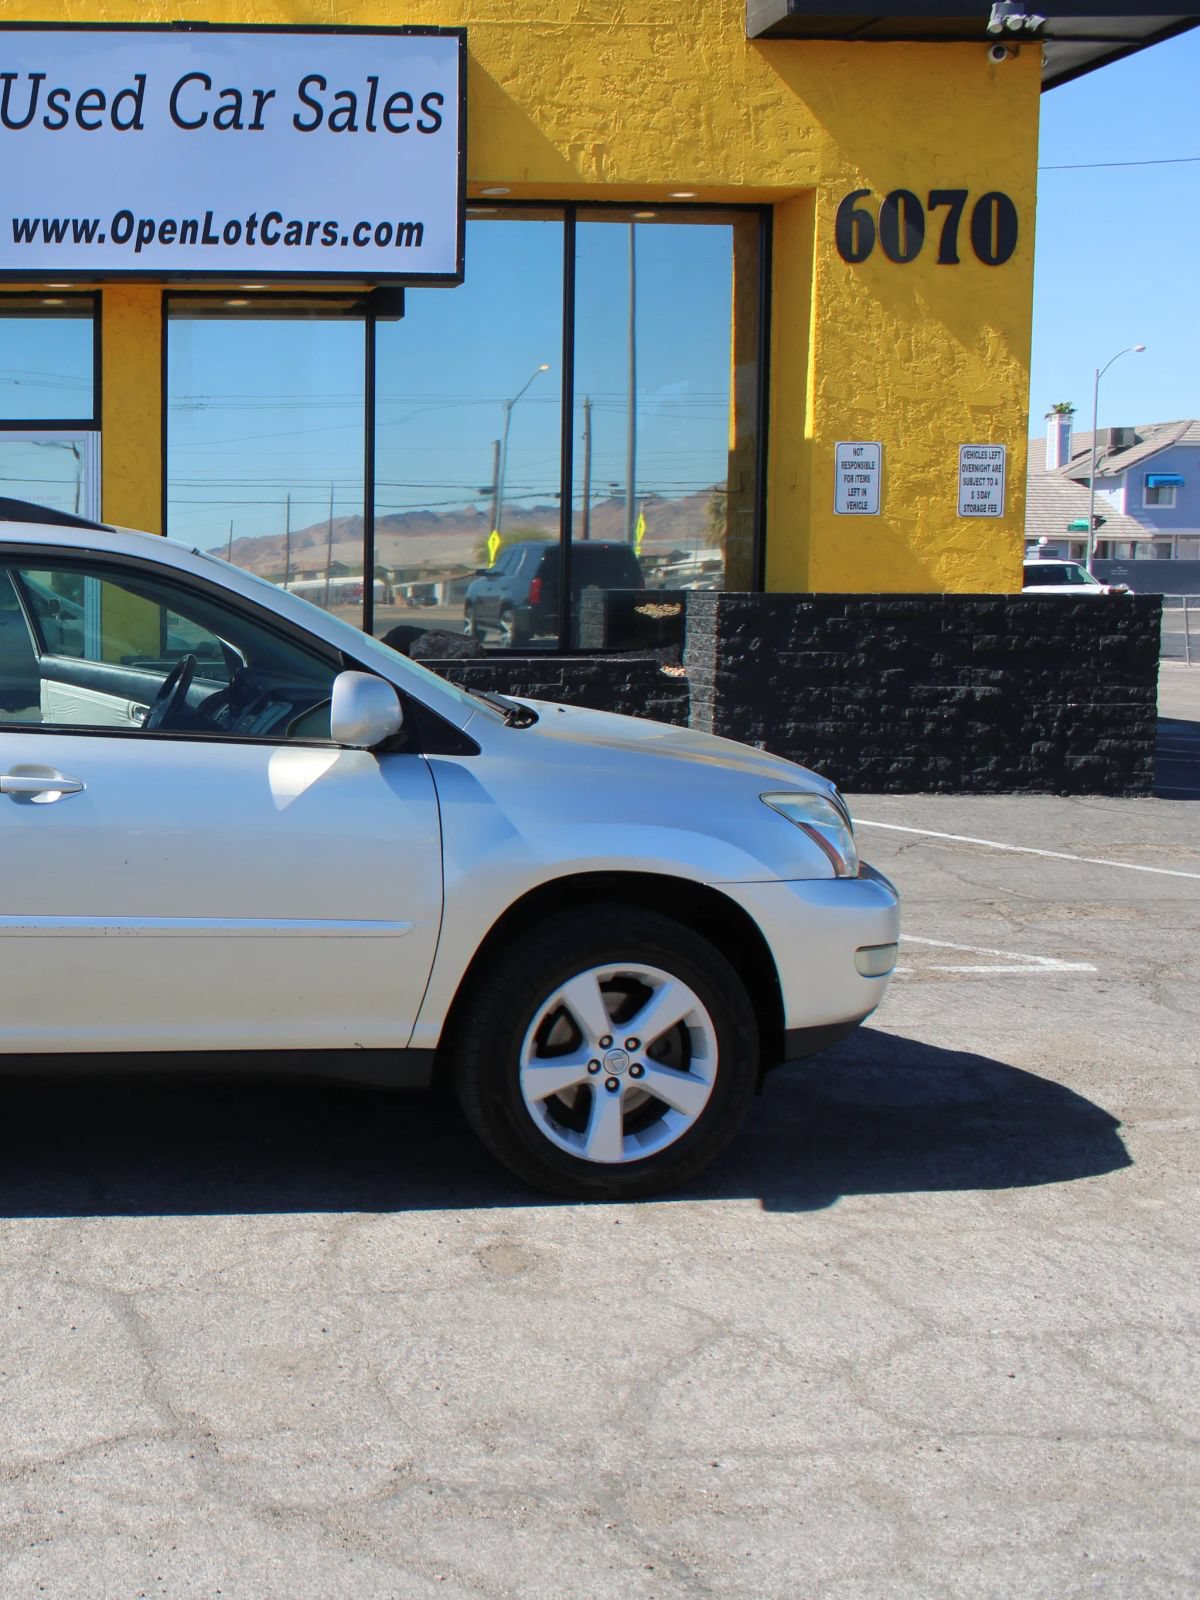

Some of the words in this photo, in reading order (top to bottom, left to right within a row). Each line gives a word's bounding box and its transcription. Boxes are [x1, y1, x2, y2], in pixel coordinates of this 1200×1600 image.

[0, 72, 147, 131] Used
[169, 71, 276, 131] Car
[292, 73, 444, 134] Sales
[11, 209, 424, 253] www.OpenLotCars.com
[835, 188, 1019, 266] 6070
[852, 447, 864, 457] NOT
[963, 450, 988, 460] VEHICLES
[988, 450, 1001, 460] LEFT
[841, 461, 876, 470] RESPONSIBLE
[961, 463, 991, 473] OVERNIGHT
[991, 464, 1002, 473] ARE
[843, 474, 854, 484] FOR
[855, 474, 871, 484] ITEMS
[962, 477, 986, 486] SUBJECT
[986, 477, 994, 486] TO
[847, 487, 860, 497] LEFT
[860, 487, 867, 497] IN
[846, 501, 868, 510] VEHICLE
[963, 503, 987, 513] STORAGE
[987, 504, 998, 513] FEE
